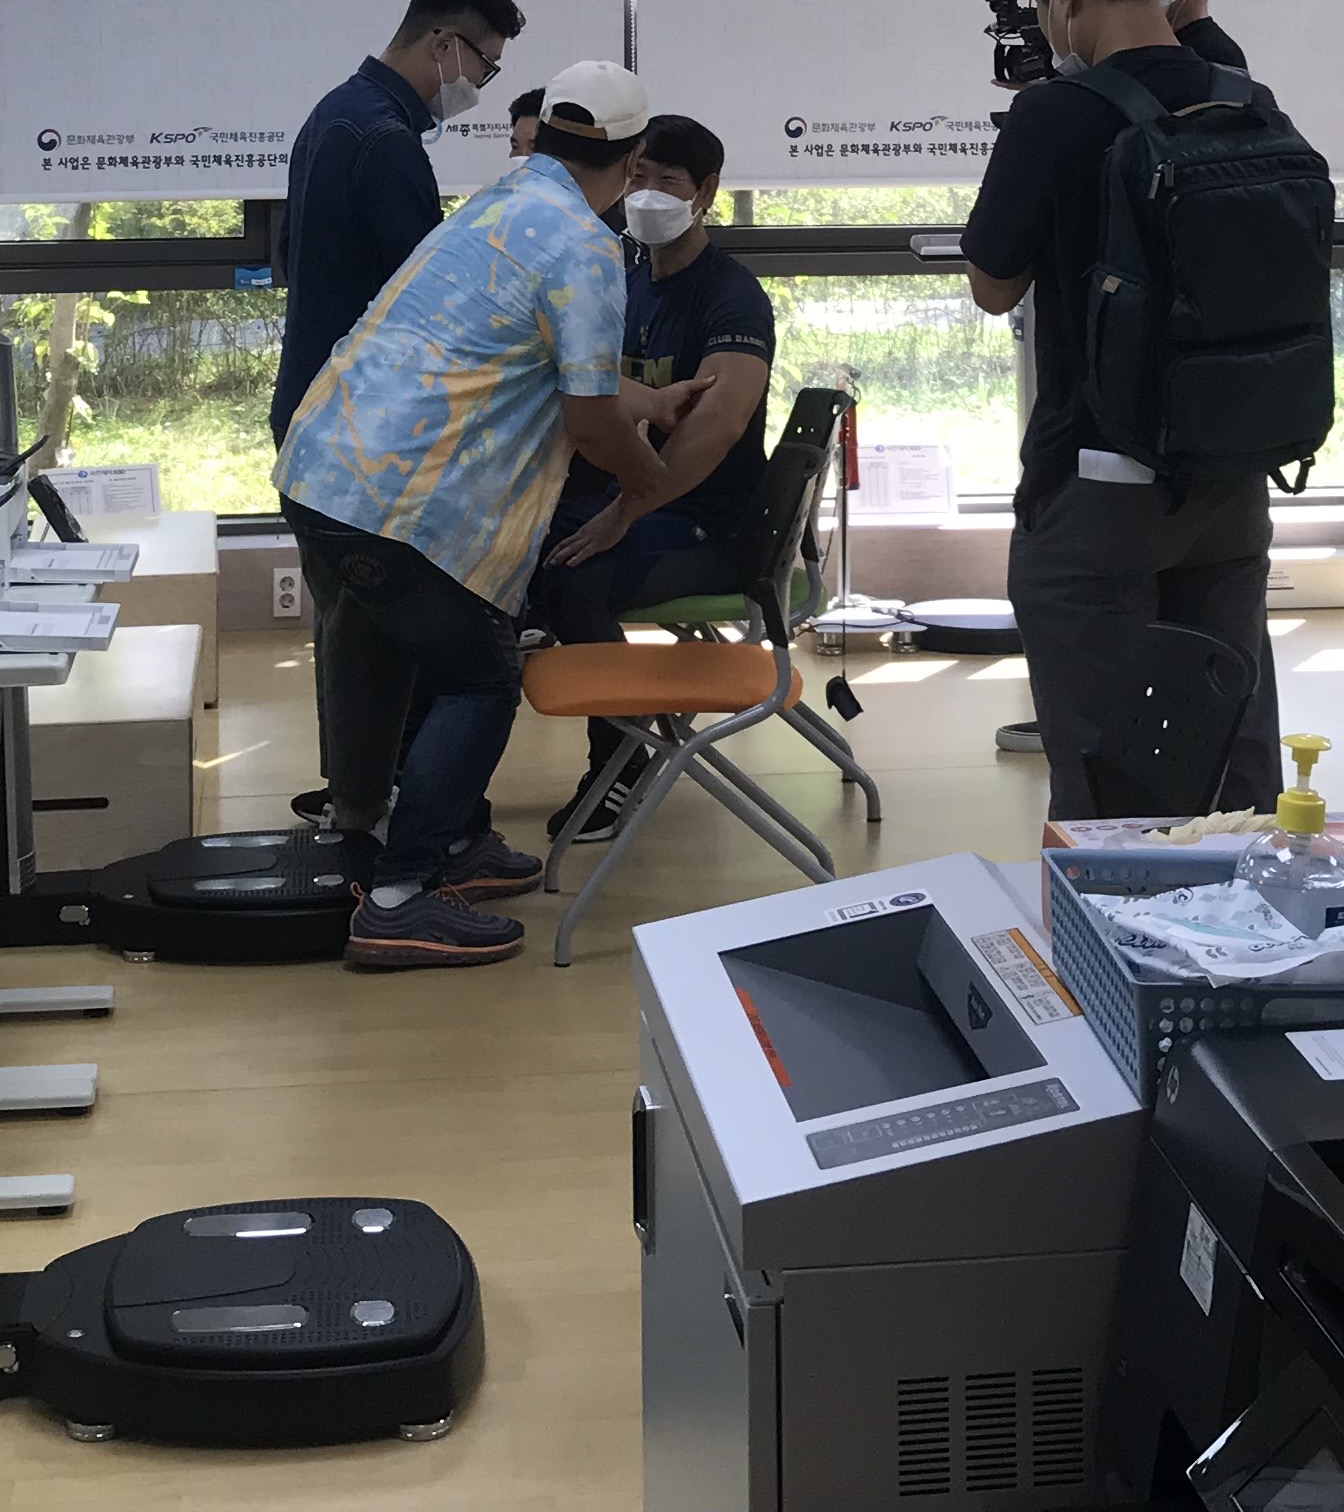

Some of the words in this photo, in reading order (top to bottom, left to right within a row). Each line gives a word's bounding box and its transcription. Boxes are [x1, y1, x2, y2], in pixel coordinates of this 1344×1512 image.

[889, 121, 933, 132] KSPO
[149, 132, 197, 144] KSPO
[210, 131, 285, 143] 국민체육진흥공단
[789, 144, 799, 157] 본
[804, 143, 835, 157] 사업은
[839, 142, 922, 156] 문화체육관광부와
[41, 157, 53, 170] 본
[57, 156, 91, 170] 사업은
[96, 155, 185, 169] 문화체육관광부와
[190, 153, 288, 168] 국민체육진흥공단의
